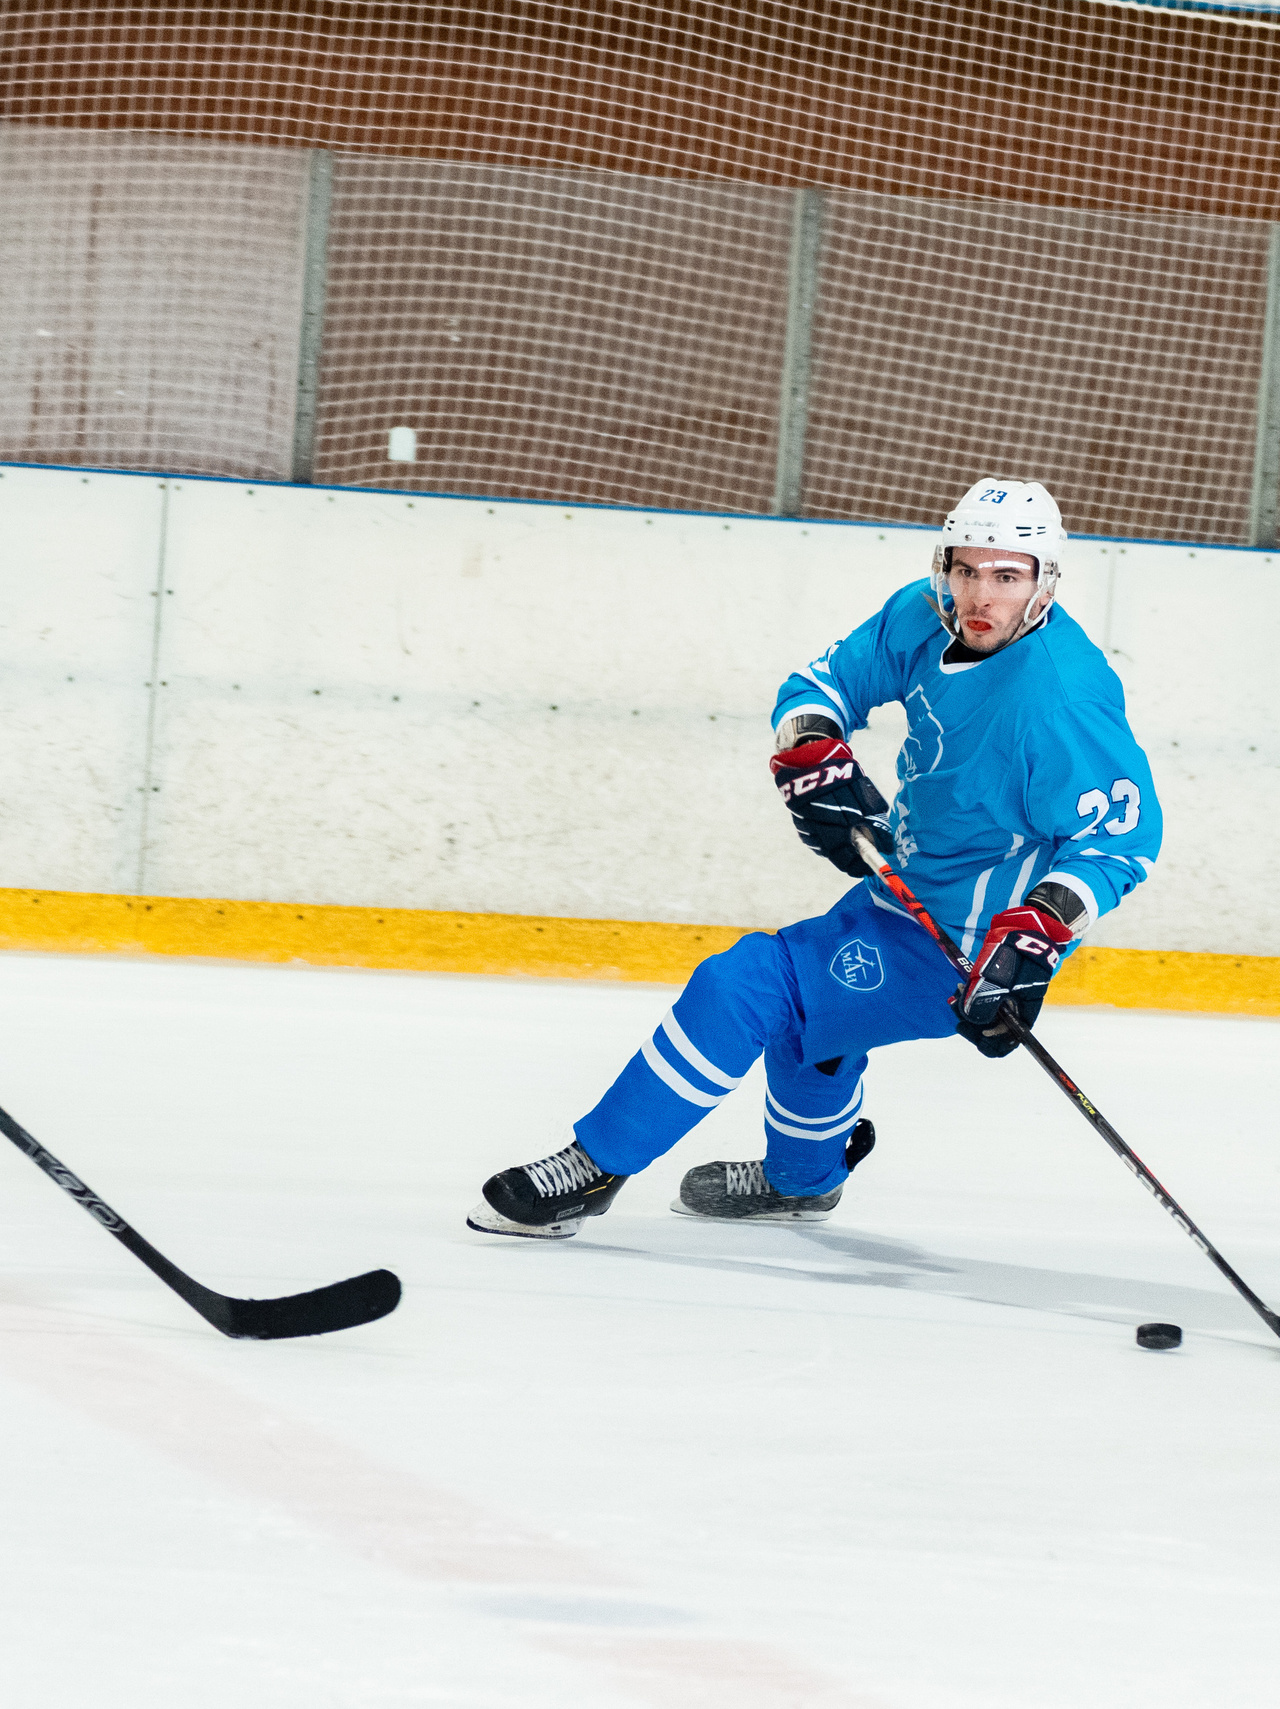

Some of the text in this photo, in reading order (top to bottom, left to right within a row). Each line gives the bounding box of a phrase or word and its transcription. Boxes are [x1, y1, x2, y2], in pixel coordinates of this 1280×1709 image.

[979, 489, 1008, 504] 23
[1070, 777, 1141, 842] 23
[1015, 933, 1060, 969] CC
